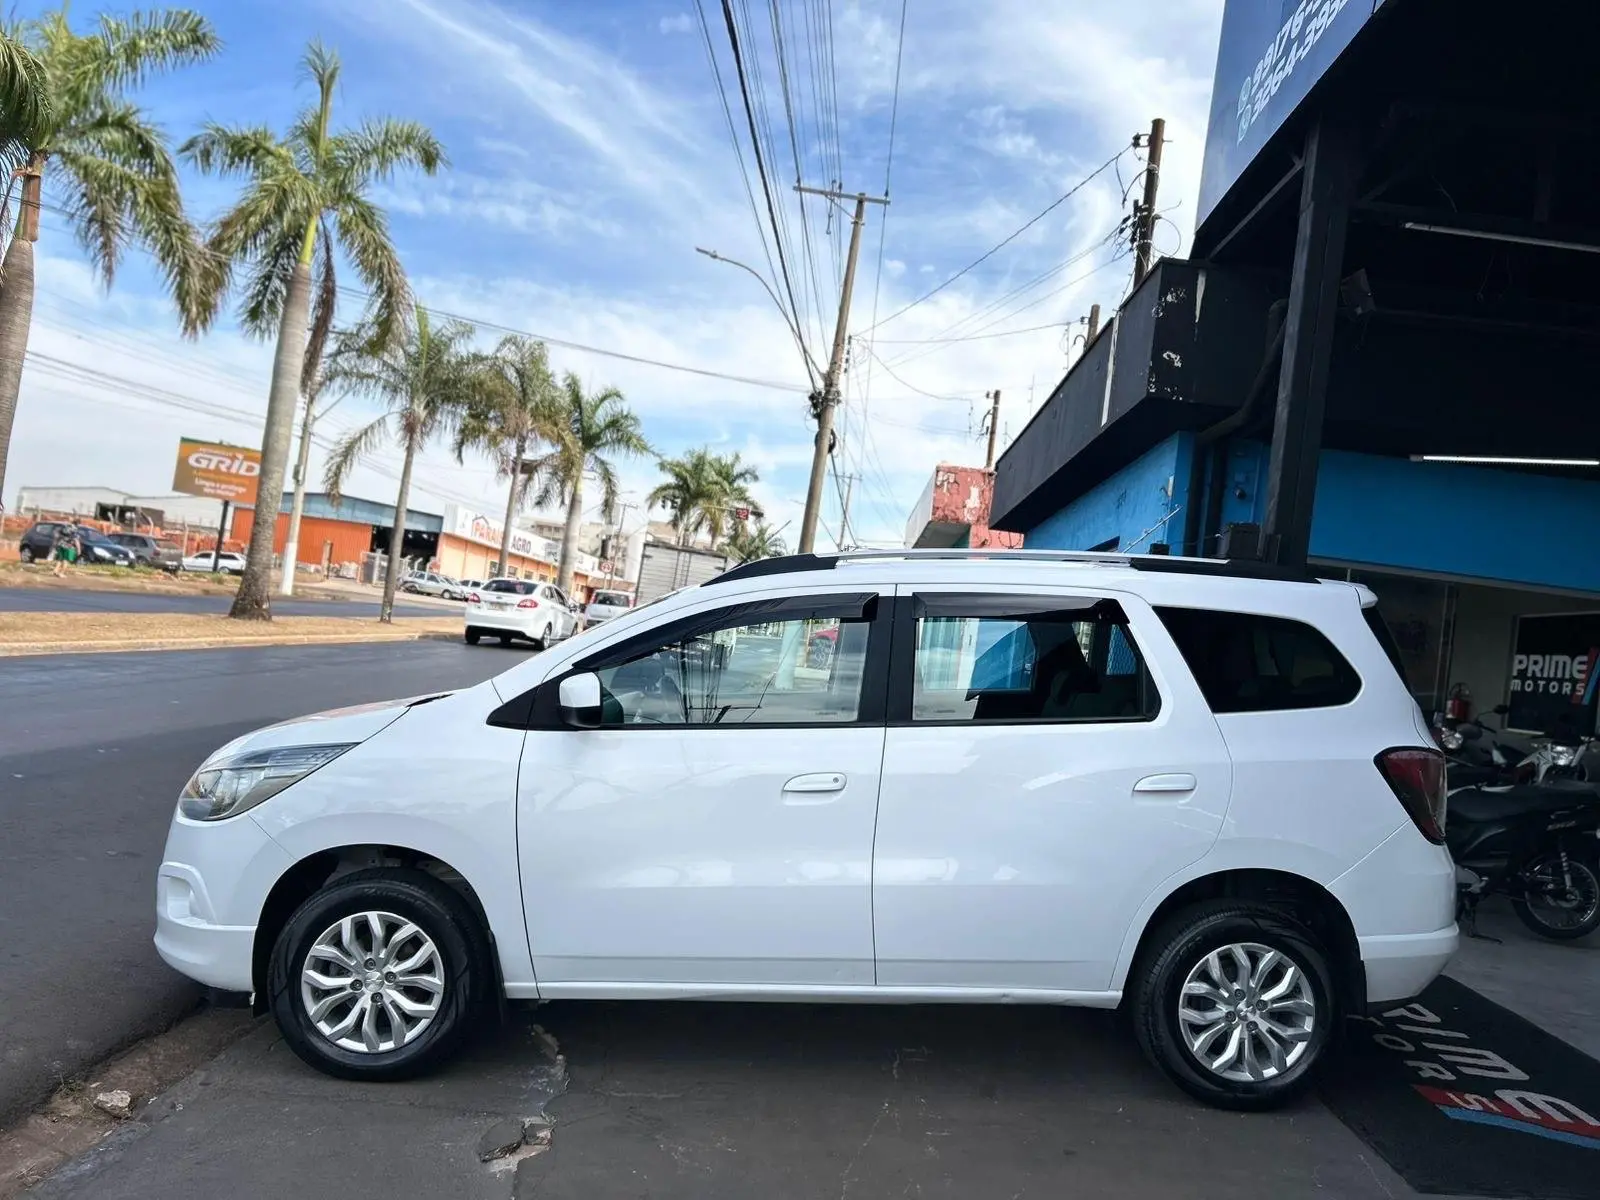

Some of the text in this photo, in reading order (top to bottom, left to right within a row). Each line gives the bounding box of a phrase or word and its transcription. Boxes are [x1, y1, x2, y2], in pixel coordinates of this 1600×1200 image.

[1250, 0, 1321, 96] 99176-
[187, 452, 260, 477] GRID
[511, 535, 532, 554] AGRO
[1512, 654, 1589, 679] PRIME
[1510, 679, 1585, 696] MOTORS
